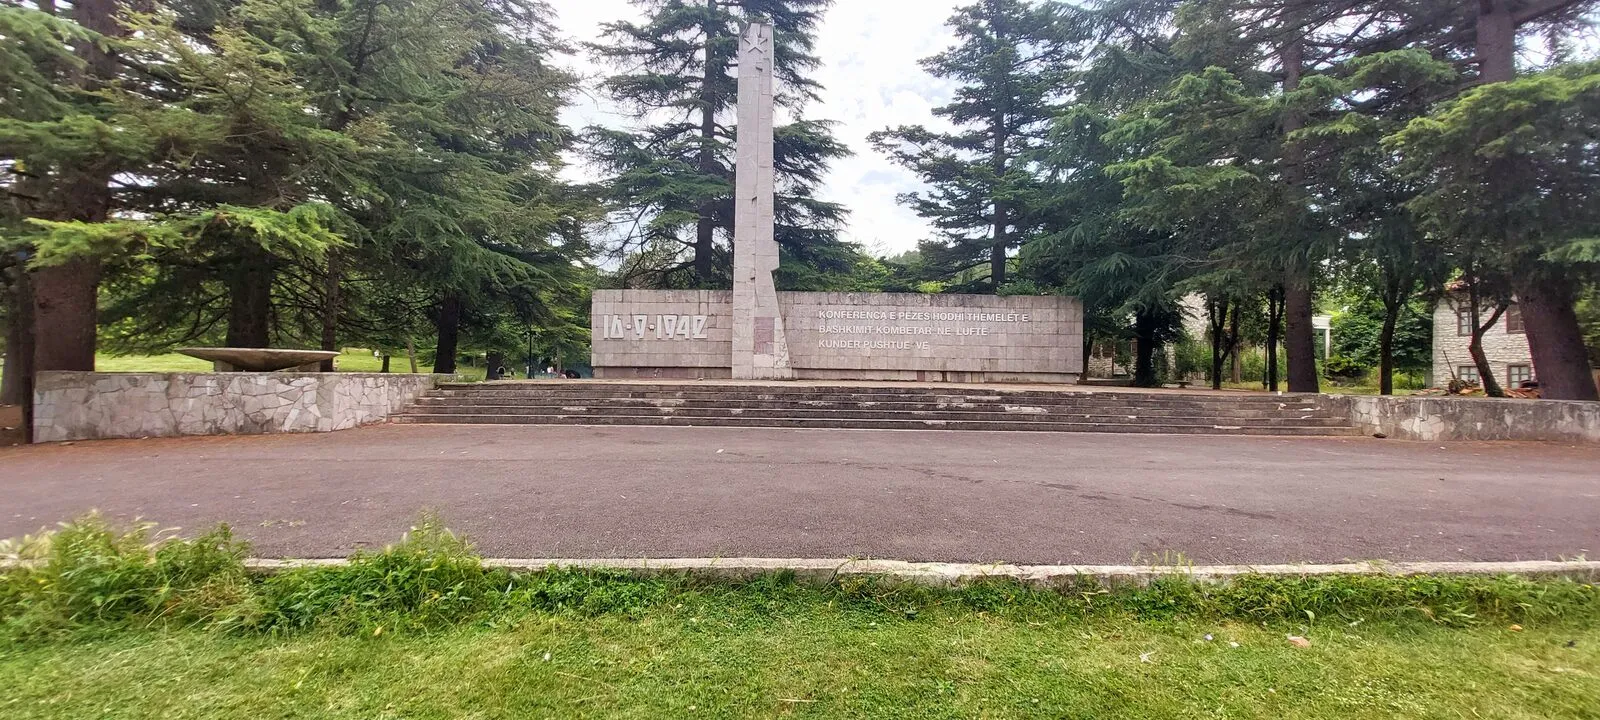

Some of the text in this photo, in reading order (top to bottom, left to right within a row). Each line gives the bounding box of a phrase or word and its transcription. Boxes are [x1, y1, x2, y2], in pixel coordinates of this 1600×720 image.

[818, 310, 887, 320] KONFERENCA
[890, 311, 896, 320] E
[933, 312, 964, 321] HODHI
[1022, 314, 1028, 322] E
[818, 325, 988, 336] BASHKIMIT KOMBETAR NE LUFTE
[818, 339, 860, 348] KUNDER
